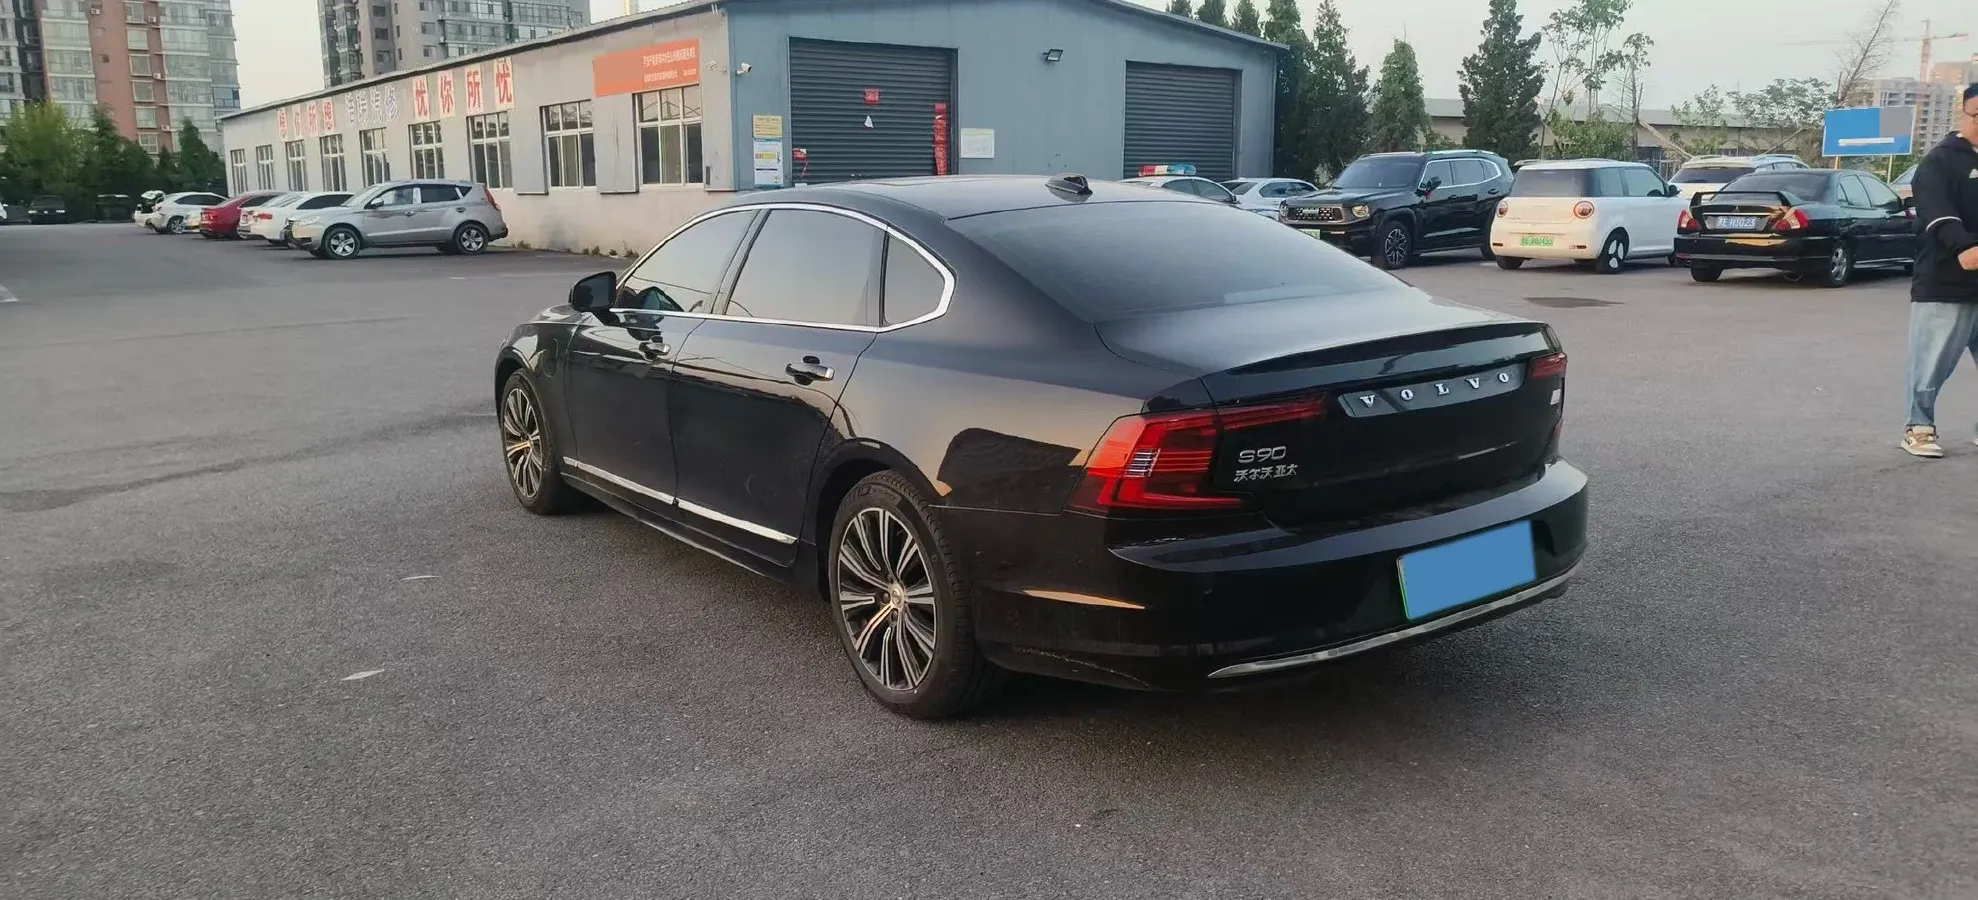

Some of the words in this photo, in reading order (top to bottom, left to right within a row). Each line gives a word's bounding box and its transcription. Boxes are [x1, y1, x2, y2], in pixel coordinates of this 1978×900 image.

[415, 62, 513, 117] 忧你所忧
[1359, 372, 1511, 408] VOLVO
[1238, 445, 1287, 464] S90
[1233, 464, 1299, 483] 沃尔沃亚太
